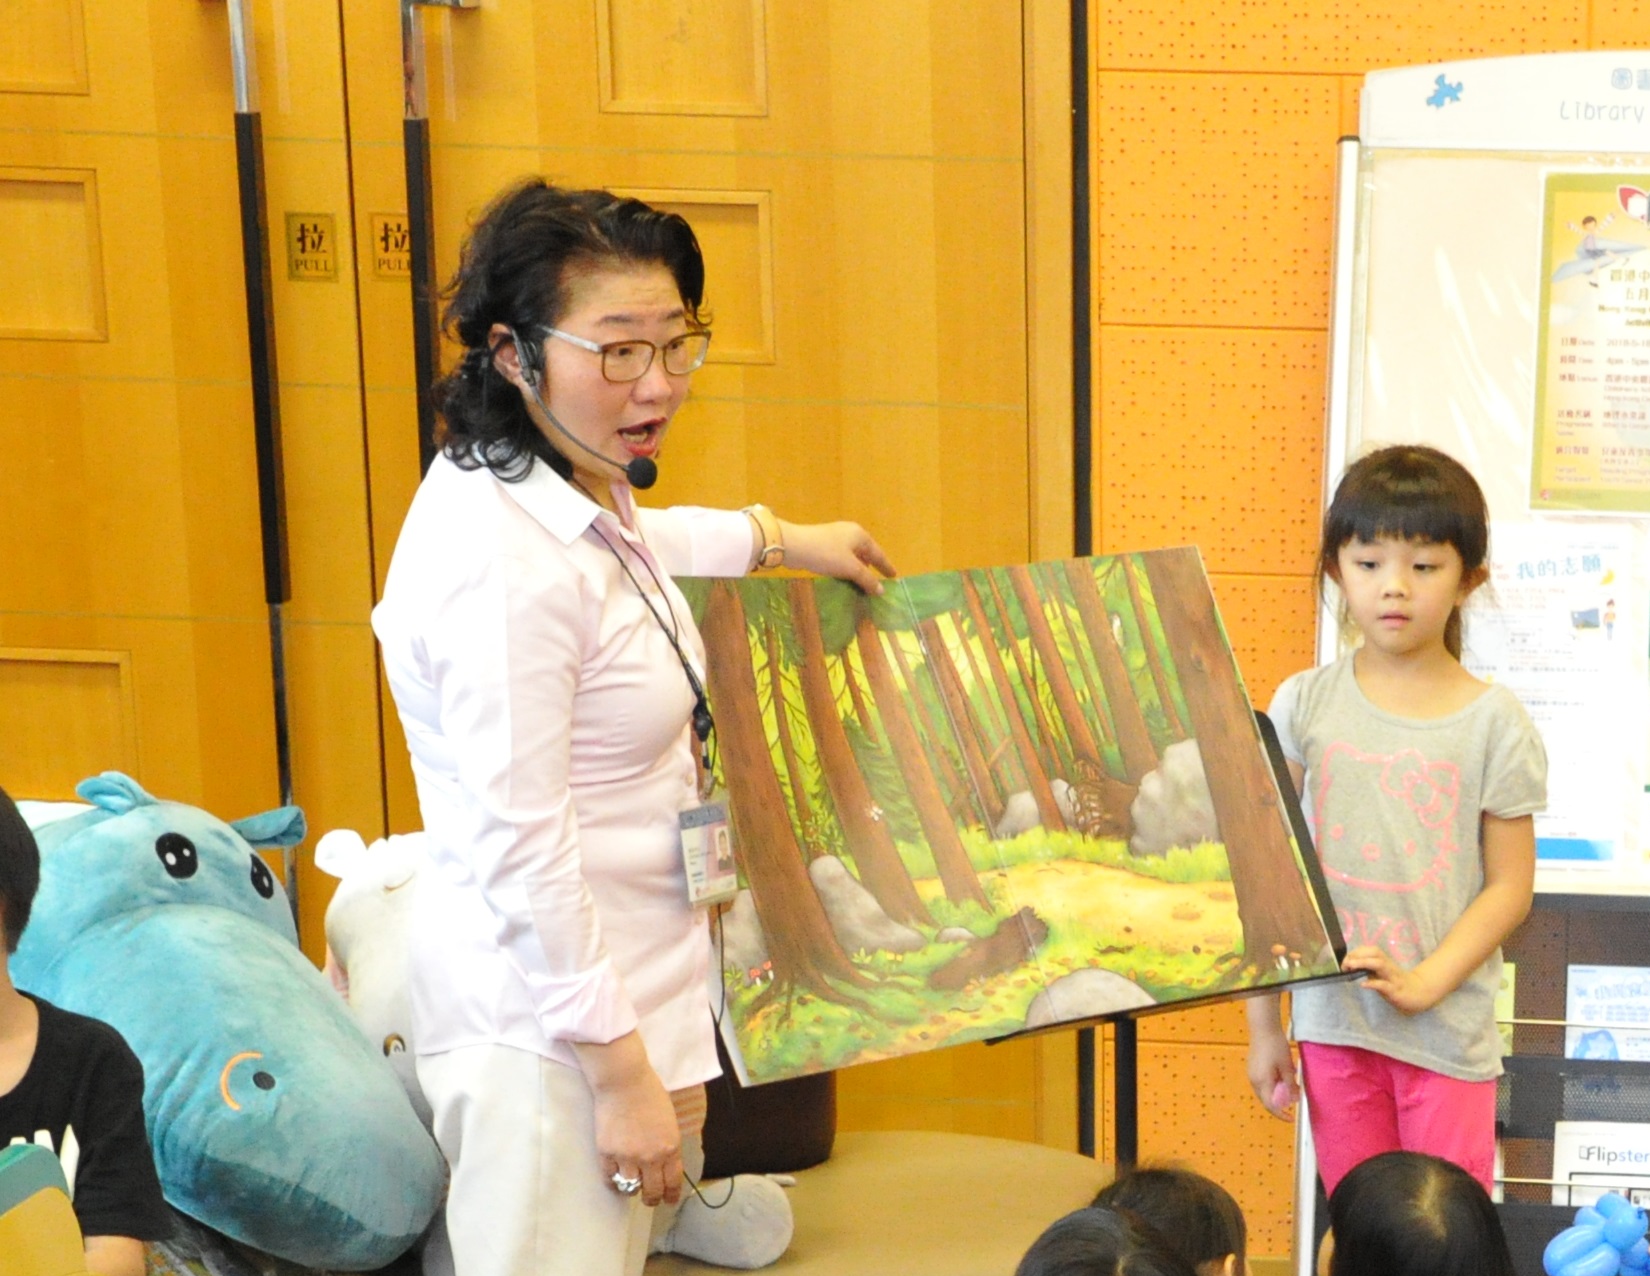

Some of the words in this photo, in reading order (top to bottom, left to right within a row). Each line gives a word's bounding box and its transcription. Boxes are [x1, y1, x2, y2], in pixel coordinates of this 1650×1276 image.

[1559, 100, 1644, 127] Library
[296, 223, 327, 254] 拉
[380, 223, 410, 253] 拉
[295, 259, 330, 272] PULL
[1517, 552, 1602, 580] 我的志願
[1586, 1144, 1650, 1166] Flipster
